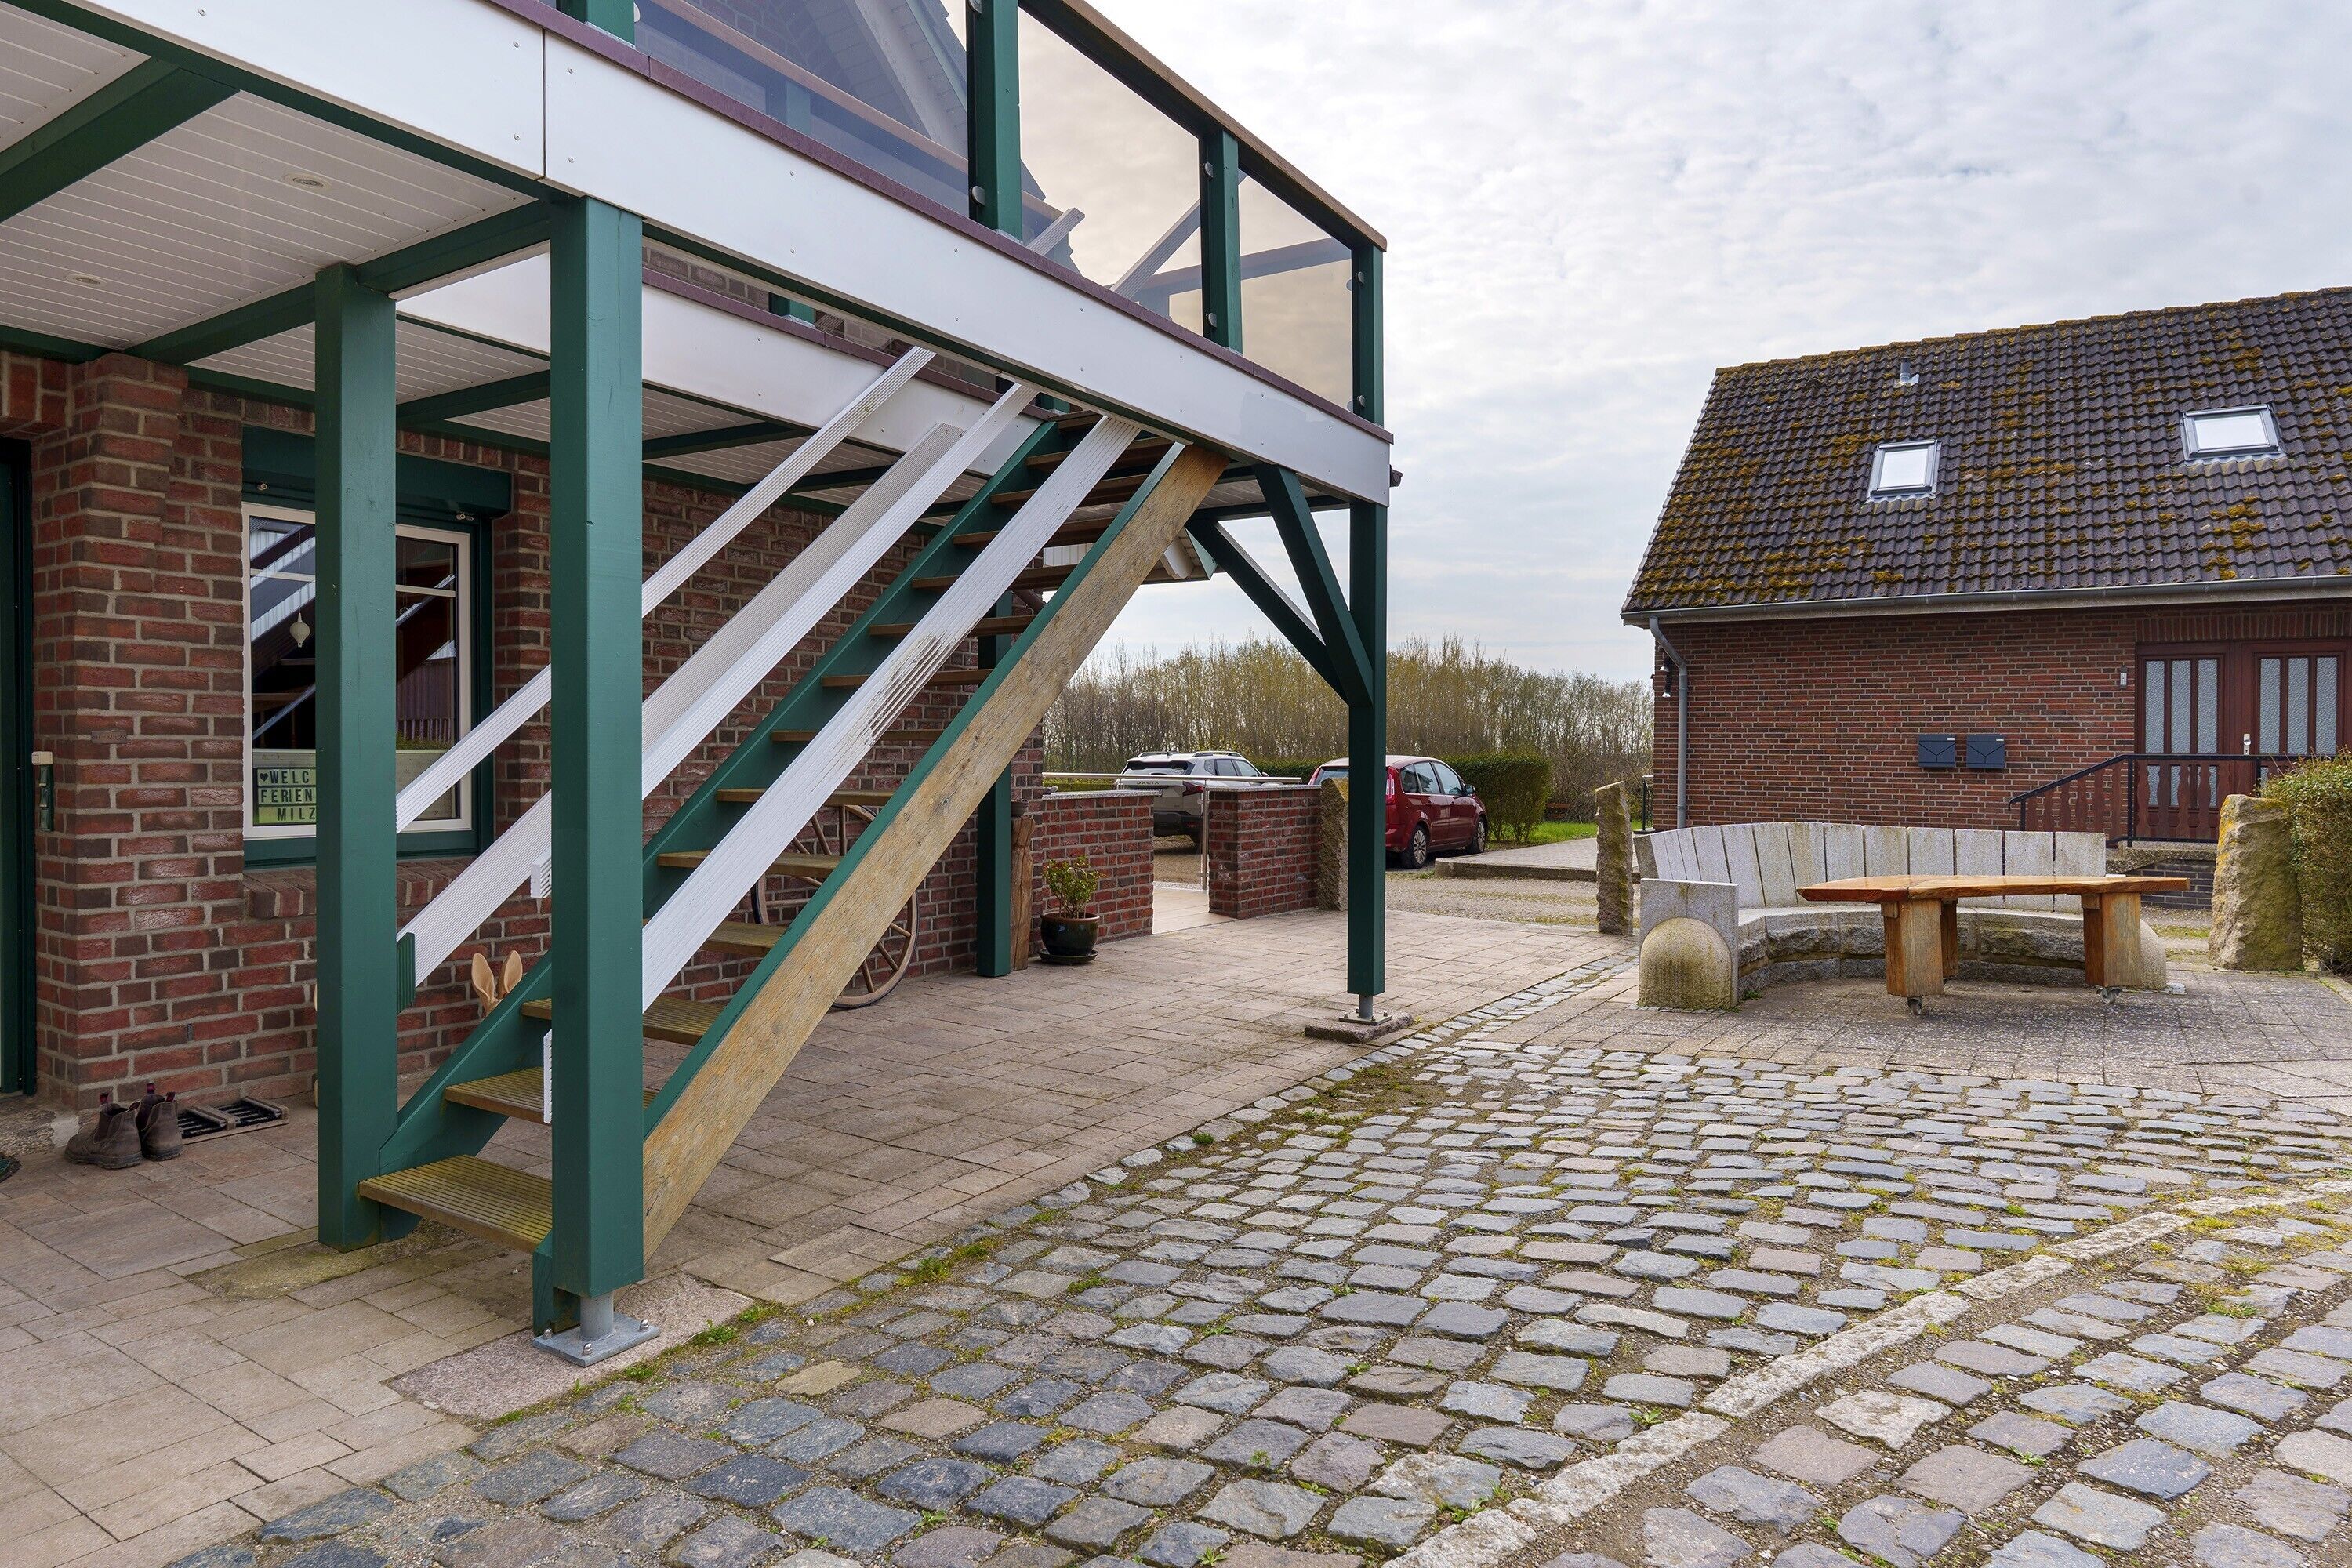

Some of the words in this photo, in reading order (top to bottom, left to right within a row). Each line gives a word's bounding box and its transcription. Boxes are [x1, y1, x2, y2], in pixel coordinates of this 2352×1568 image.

[270, 771, 310, 784] WELC
[261, 789, 313, 803] FERIEN
[277, 807, 316, 822] MILZ
